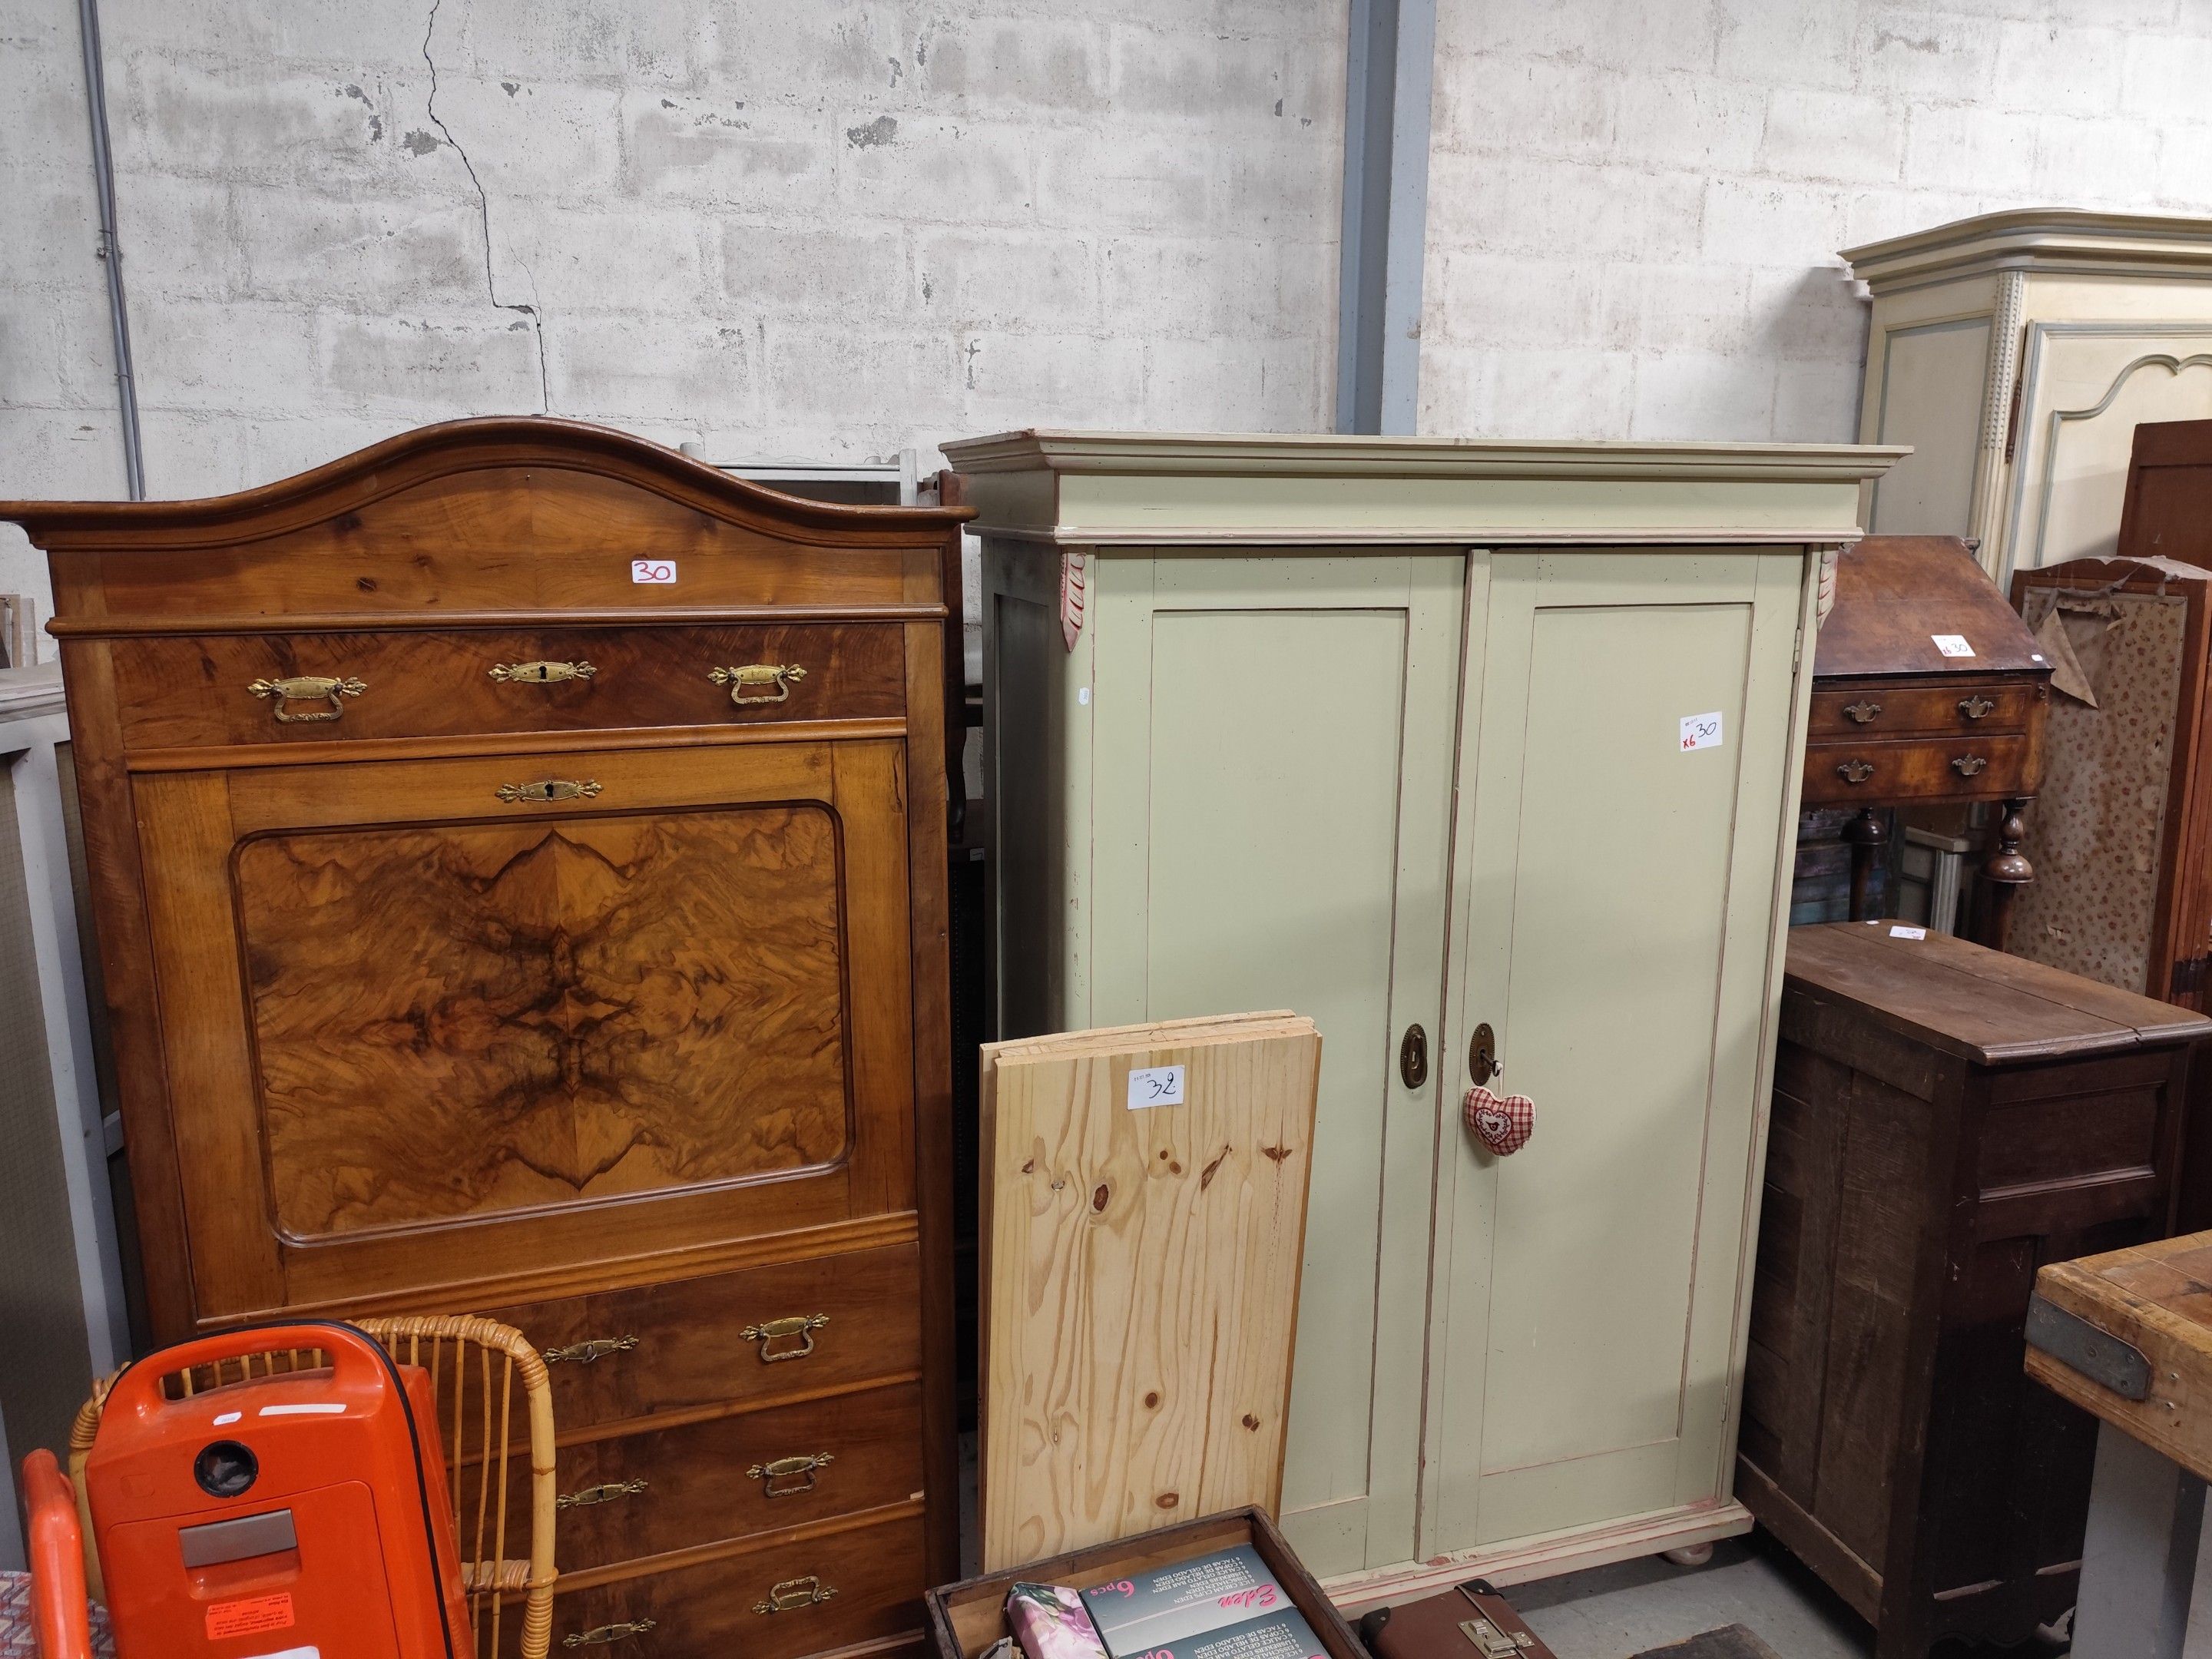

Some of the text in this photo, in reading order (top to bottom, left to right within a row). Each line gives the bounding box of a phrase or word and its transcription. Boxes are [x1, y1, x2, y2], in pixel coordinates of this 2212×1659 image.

[634, 561, 671, 581] 30
[1695, 721, 1717, 738] 30
[1147, 1071, 1177, 1099] 32
[1214, 1561, 1237, 1571] COPAS
[1172, 1566, 1201, 1578] GELADO
[1153, 1575, 1171, 1583] EDEN
[1155, 1578, 1174, 1588] EDEN
[1187, 1572, 1215, 1584] GELATO
[1152, 1585, 1170, 1594] EDEN
[1190, 1580, 1208, 1588] EDEN
[1185, 1586, 1204, 1594] EDEN
[1194, 1589, 1213, 1598] CUPS
[1174, 1594, 1193, 1604] EDEN
[1217, 1584, 1278, 1609] Eden
[1214, 1634, 1244, 1647] GELADO
[1259, 1629, 1284, 1641] COPAS
[1194, 1644, 1214, 1654] EDEN
[1196, 1648, 1217, 1659] EDEN
[1230, 1642, 1260, 1654] GELATO
